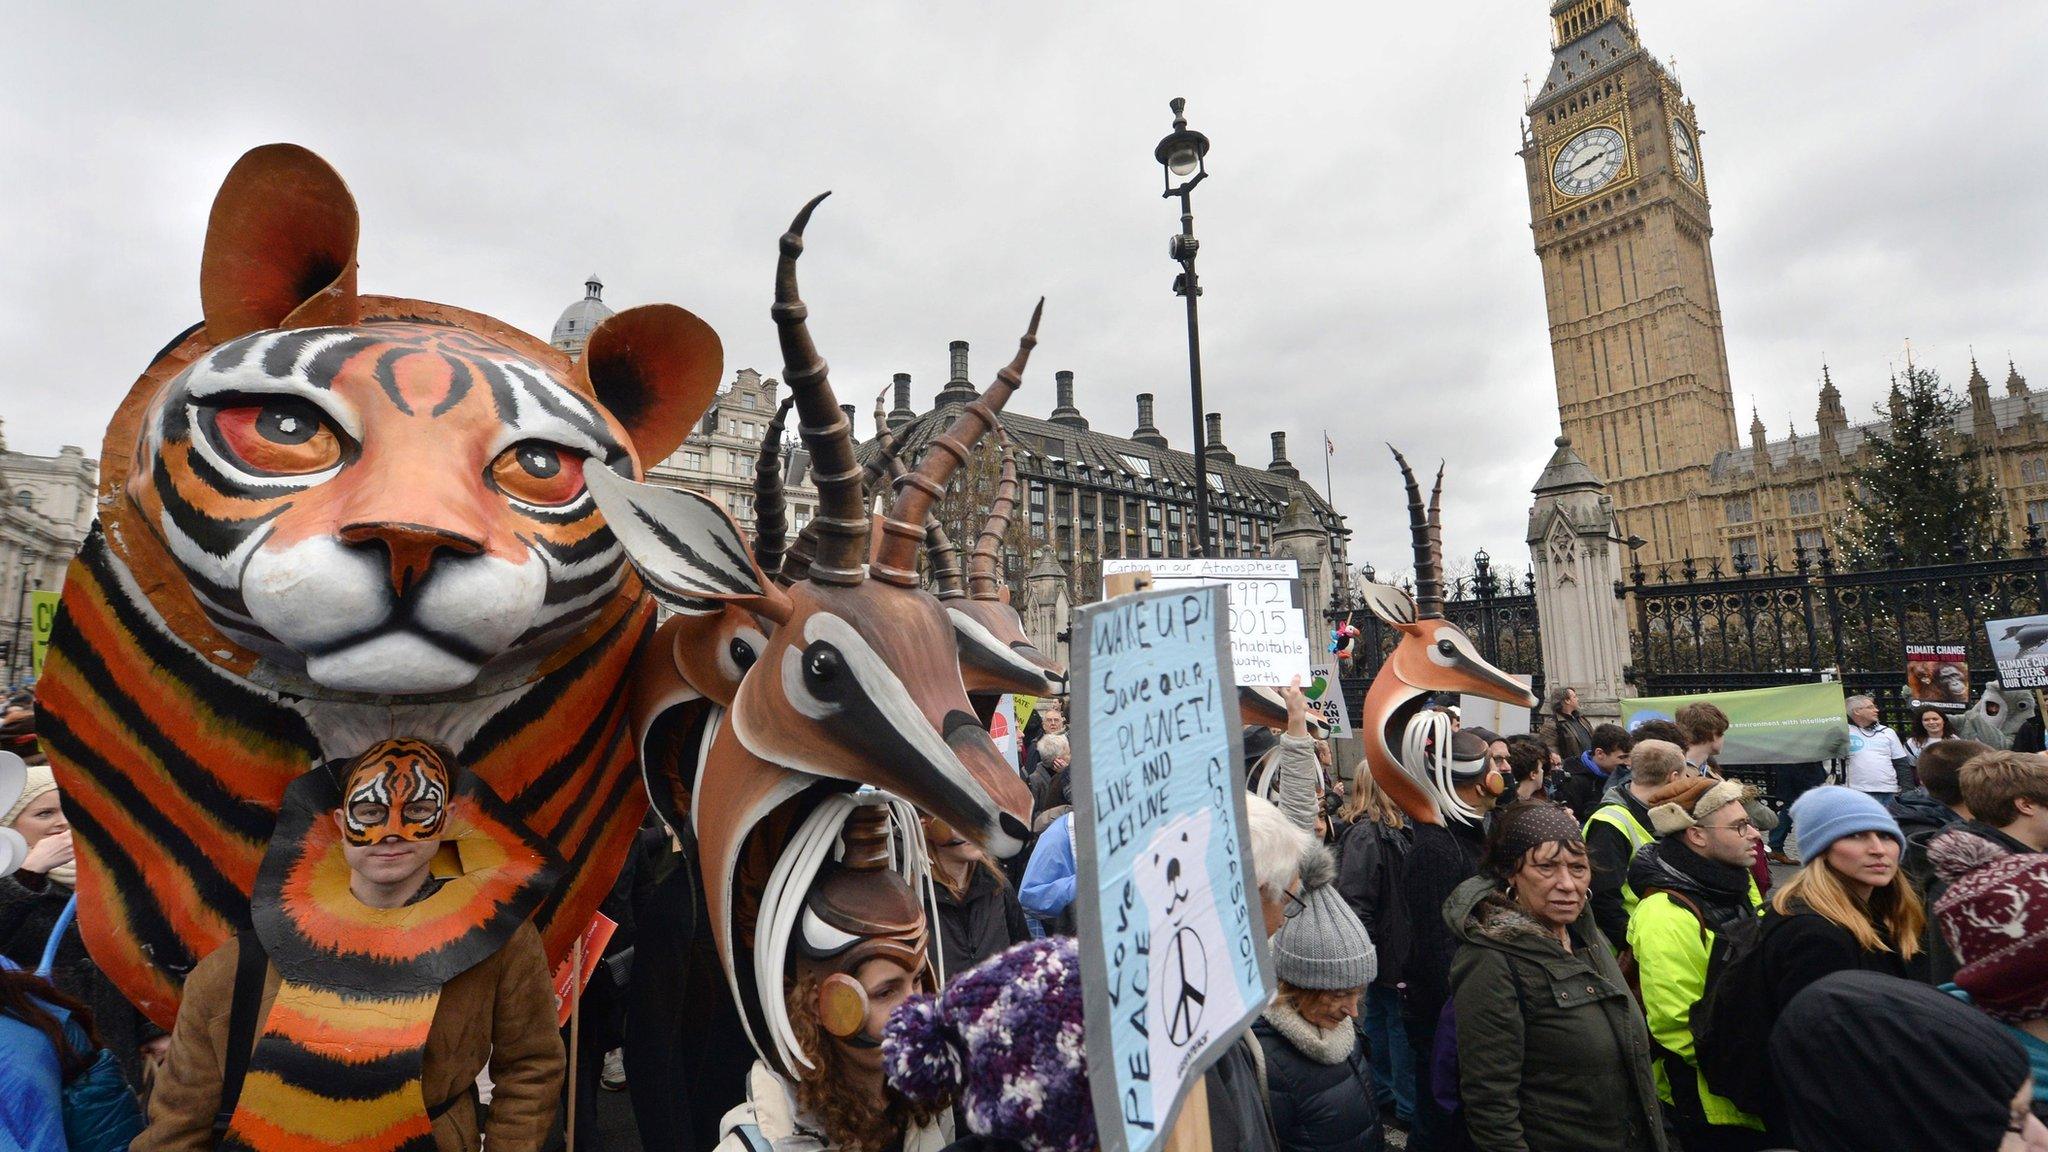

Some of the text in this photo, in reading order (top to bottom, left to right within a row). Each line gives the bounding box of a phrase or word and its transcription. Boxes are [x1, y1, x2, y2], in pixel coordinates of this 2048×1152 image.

[1107, 562, 1287, 574] Carbon in our Atmosphere
[1227, 582, 1285, 606] 1992
[1093, 600, 1152, 656] WAKE
[1228, 610, 1287, 635] 2015
[1906, 645, 1966, 655] CLIMATE CHANGE
[1997, 659, 2031, 670] CLIMATE
[1242, 672, 1280, 683] earth
[2000, 667, 2046, 679] THREATENS
[2003, 678, 2020, 688] OUR
[1103, 671, 1152, 715] Save
[1735, 720, 1780, 728] environment
[1782, 718, 1799, 726] with
[1800, 715, 1841, 725] intelligence
[1142, 751, 1171, 787] AND
[1125, 931, 1154, 1131] PEACE
